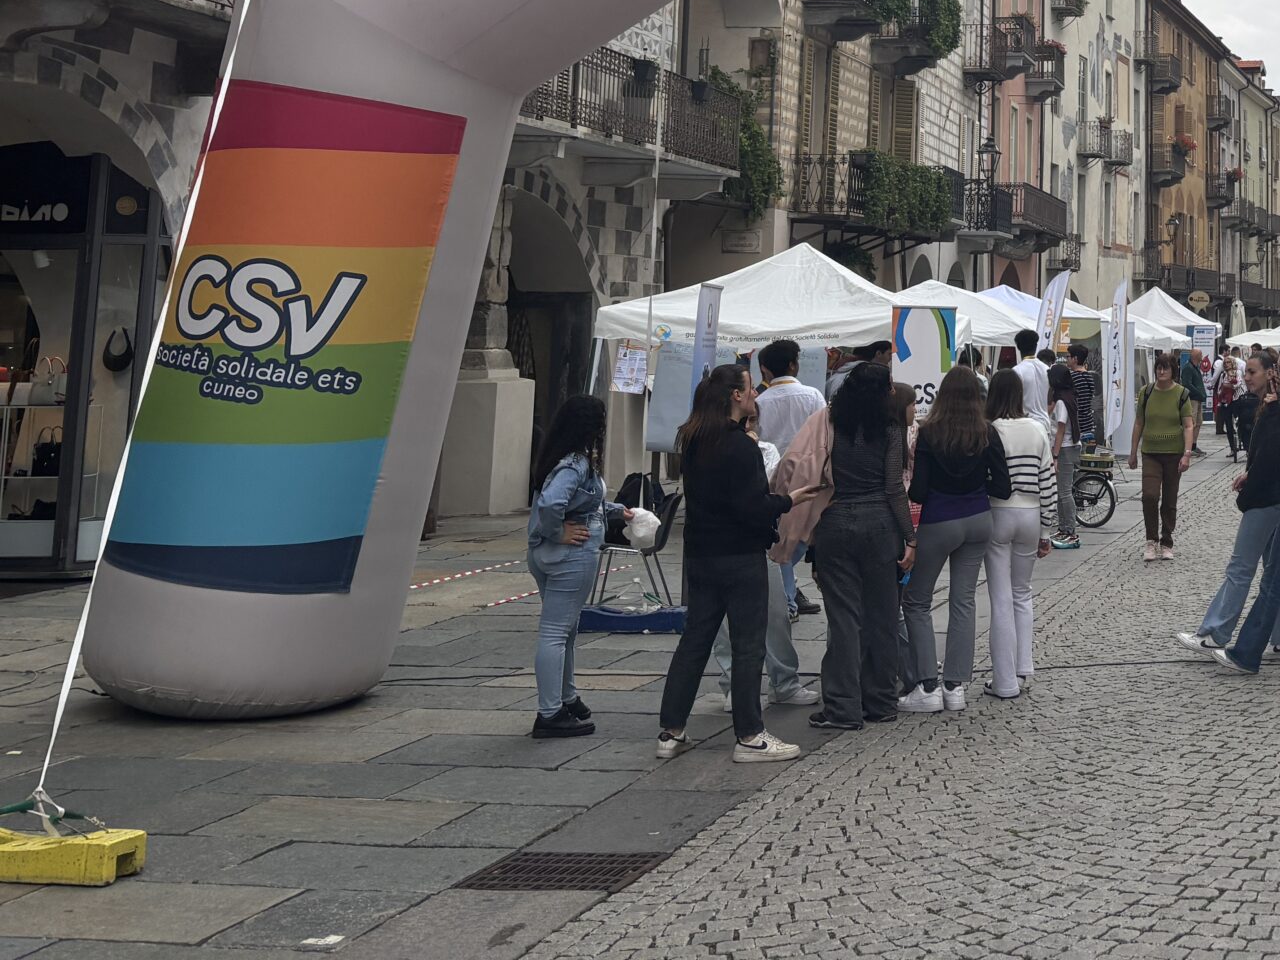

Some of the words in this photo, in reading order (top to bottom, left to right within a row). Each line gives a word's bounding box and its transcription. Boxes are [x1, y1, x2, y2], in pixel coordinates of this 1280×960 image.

[156, 345, 210, 372] società
[216, 355, 310, 386] solidale
[316, 371, 358, 391] ets
[202, 380, 259, 401] cuneo
[913, 382, 939, 405] CS
